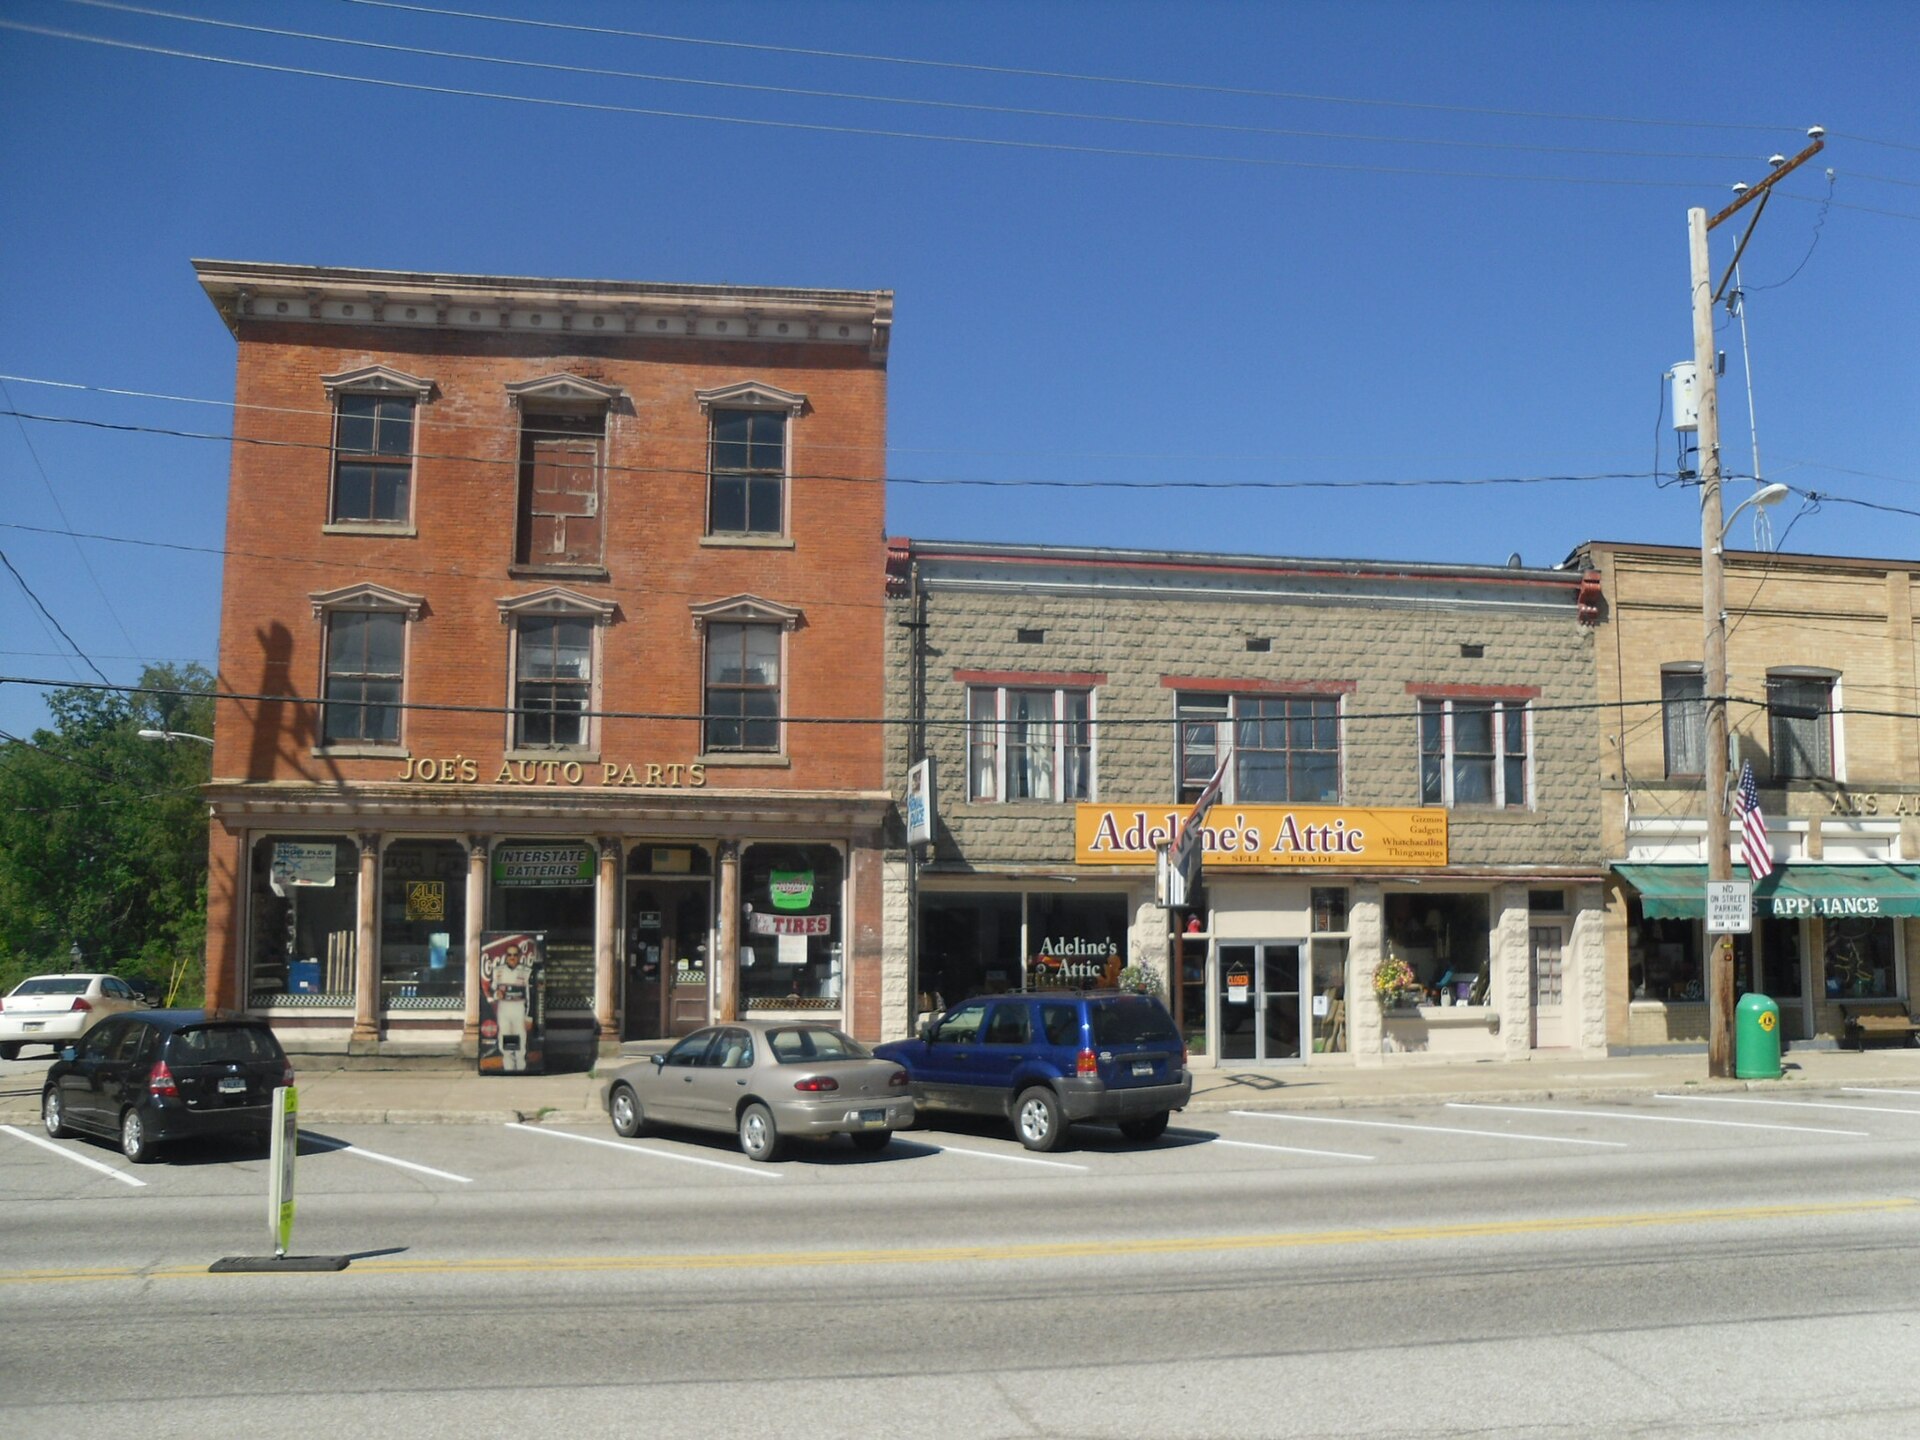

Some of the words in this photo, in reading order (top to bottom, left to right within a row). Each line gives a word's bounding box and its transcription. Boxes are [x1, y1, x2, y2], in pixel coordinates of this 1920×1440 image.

[398, 754, 479, 783] JOE'S
[495, 760, 585, 785] AUTO
[602, 763, 707, 788] PARTS
[1411, 815, 1443, 823] Gizmos
[1090, 811, 1260, 851] Adelne's
[1271, 812, 1365, 854] Attic
[1409, 825, 1443, 836] Gadgets
[499, 850, 587, 863] INTERSTATE
[1232, 855, 1263, 863] SELL
[506, 864, 579, 877] BATTERIES
[410, 883, 442, 898] ALL
[1722, 884, 1734, 893] NO
[409, 897, 442, 913] PRO
[1710, 895, 1719, 903] ON
[1722, 895, 1746, 903] STREET
[1773, 897, 1880, 914] APPLIANCE
[1714, 904, 1743, 912] PARKING
[773, 916, 828, 934] TIRES
[1040, 936, 1117, 955] Adeline's
[1056, 958, 1101, 977] Attic
